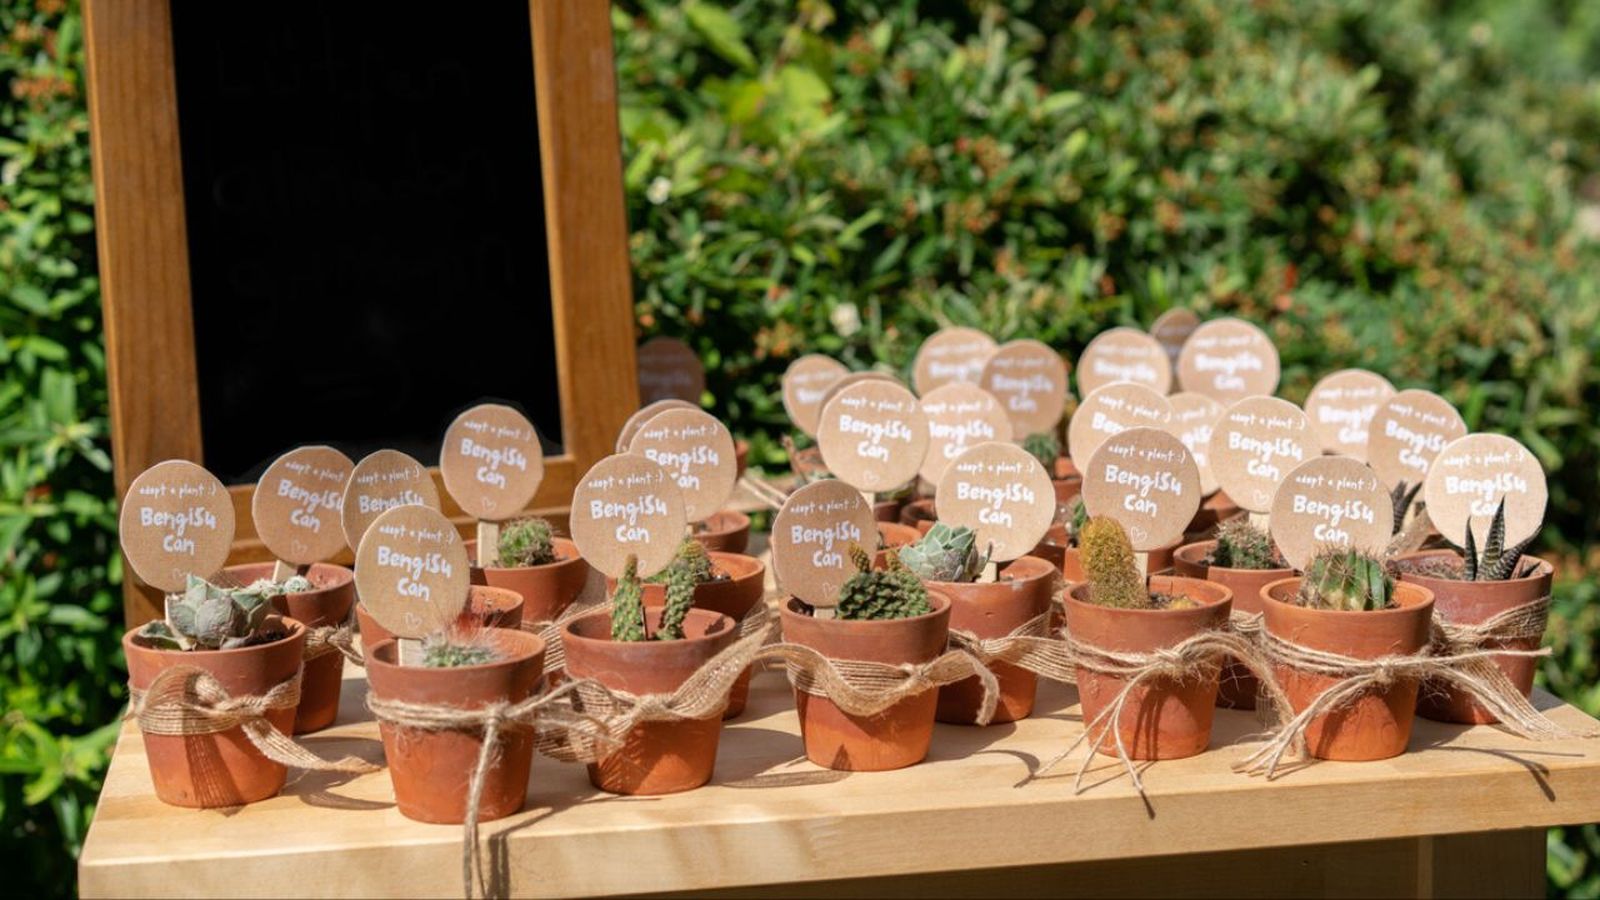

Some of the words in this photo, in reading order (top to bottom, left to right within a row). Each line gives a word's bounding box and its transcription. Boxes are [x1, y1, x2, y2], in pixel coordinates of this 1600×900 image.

[858, 441, 889, 462] Can
[477, 466, 506, 489] Can
[670, 472, 700, 490] an
[1105, 464, 1182, 497] BengiSu
[1247, 459, 1279, 482] Can
[957, 482, 1035, 509] BengiSu
[1124, 494, 1157, 517] Can
[140, 507, 217, 536] BengiSu
[290, 509, 321, 533] Can
[590, 495, 667, 526] BengiSu
[979, 508, 1012, 528] Can
[1293, 495, 1374, 527] BengiSu
[163, 534, 195, 556] Can
[616, 525, 650, 543] Can
[792, 520, 861, 551] BengiSu
[1314, 524, 1348, 546] Can
[378, 545, 452, 580] BengiSu
[813, 550, 843, 568] Can
[397, 577, 430, 601] Can
